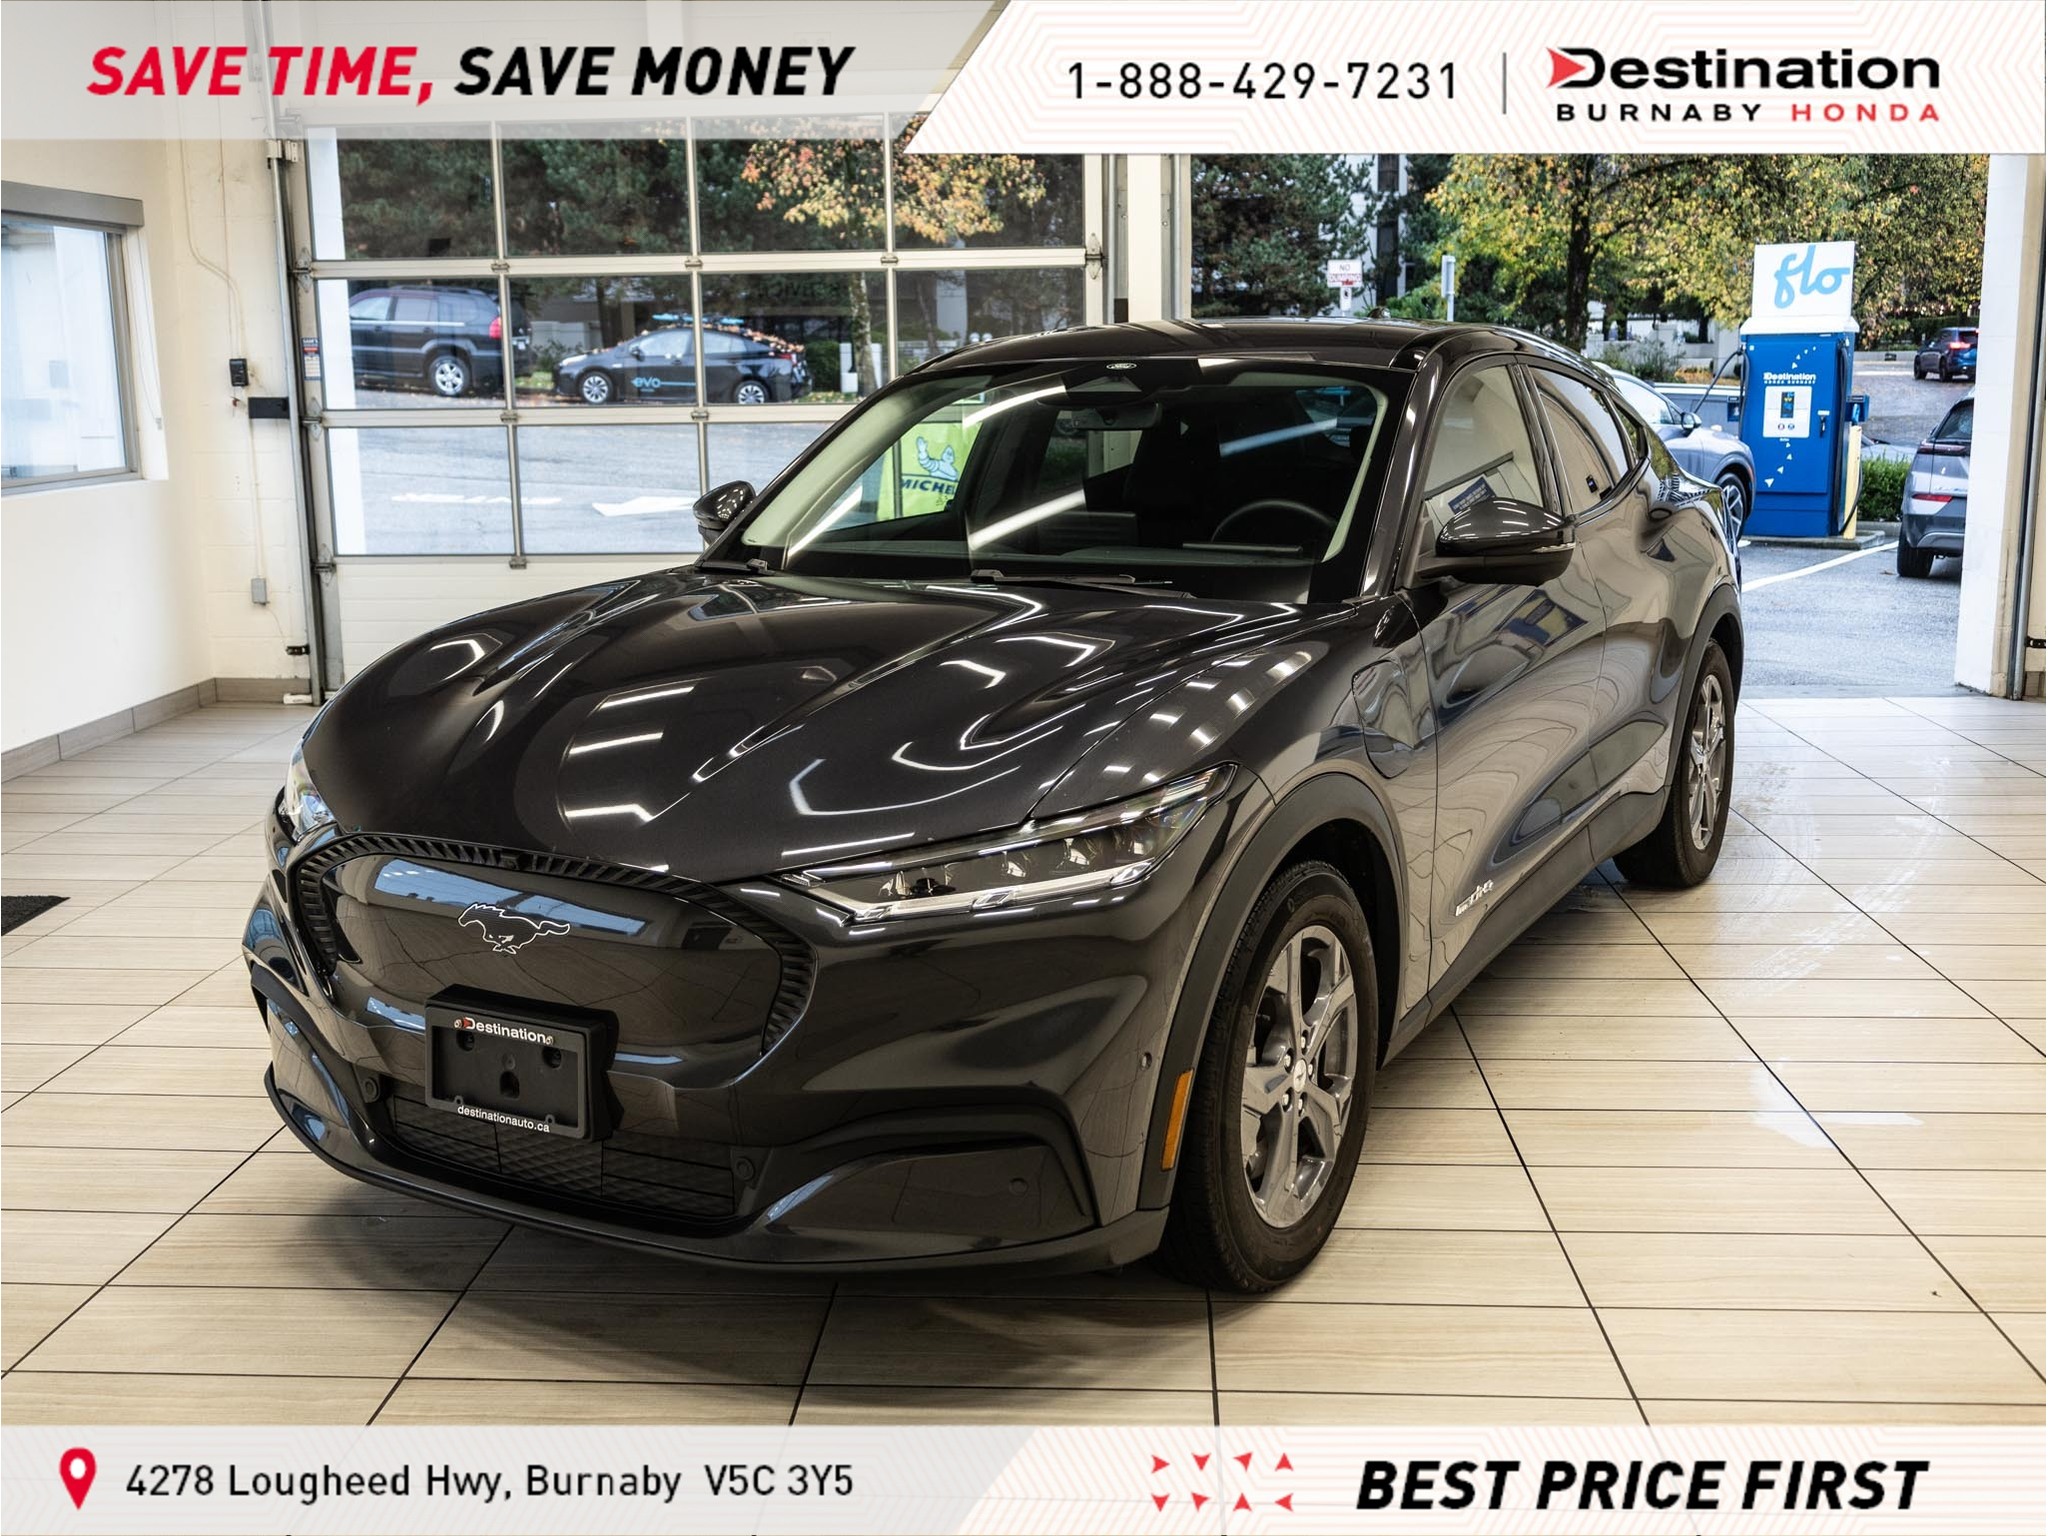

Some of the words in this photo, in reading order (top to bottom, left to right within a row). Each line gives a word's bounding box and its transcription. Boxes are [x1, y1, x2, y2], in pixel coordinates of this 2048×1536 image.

[1774, 245, 1850, 309] flo
[463, 1016, 546, 1044] Destination
[457, 1105, 550, 1133] destinationauto.ca
